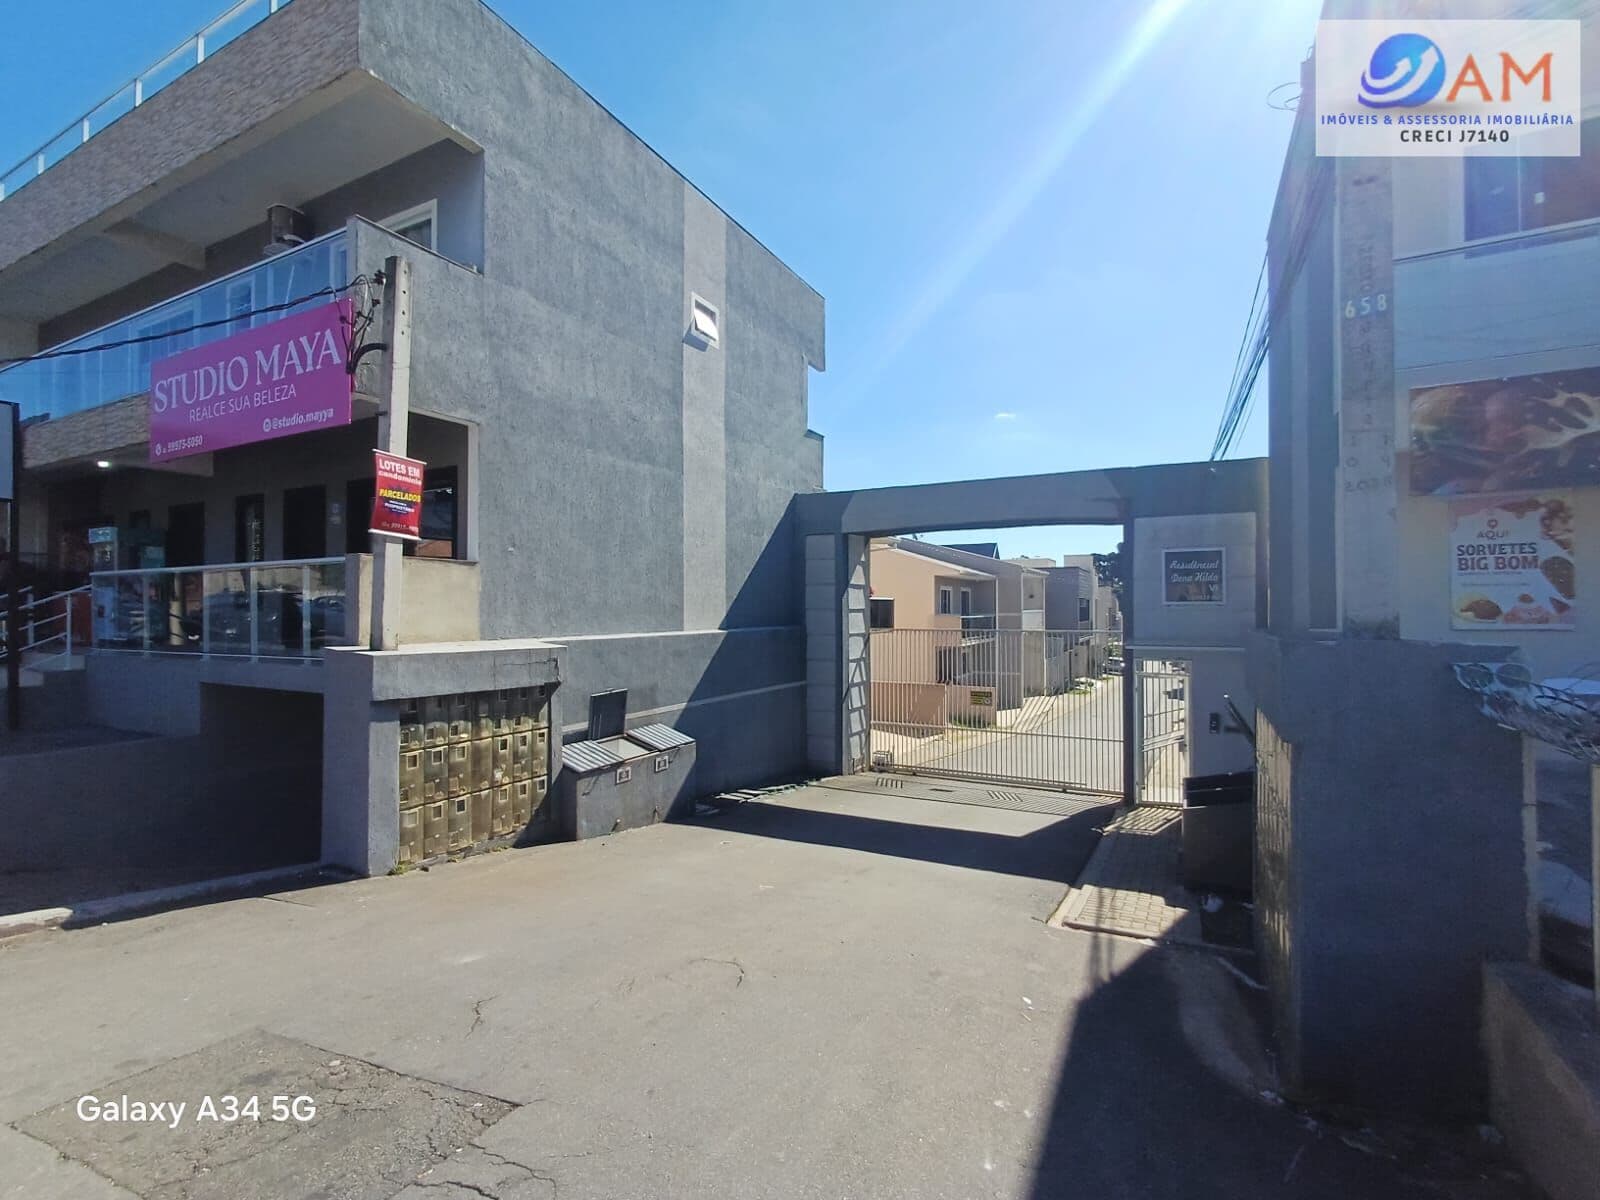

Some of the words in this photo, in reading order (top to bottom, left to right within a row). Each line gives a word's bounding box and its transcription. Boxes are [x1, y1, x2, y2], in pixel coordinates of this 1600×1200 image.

[1345, 294, 1387, 319] 658
[154, 356, 249, 413] STUDIO
[255, 328, 341, 385] MAYA
[189, 402, 227, 423] REALCE
[229, 396, 251, 413] SUA
[253, 383, 297, 408] BELEZA
[379, 459, 407, 475] LOTES
[408, 466, 420, 478] EM
[1456, 542, 1537, 557] SORVETES
[1457, 557, 1489, 571] BIG
[1493, 556, 1539, 570] BOM
